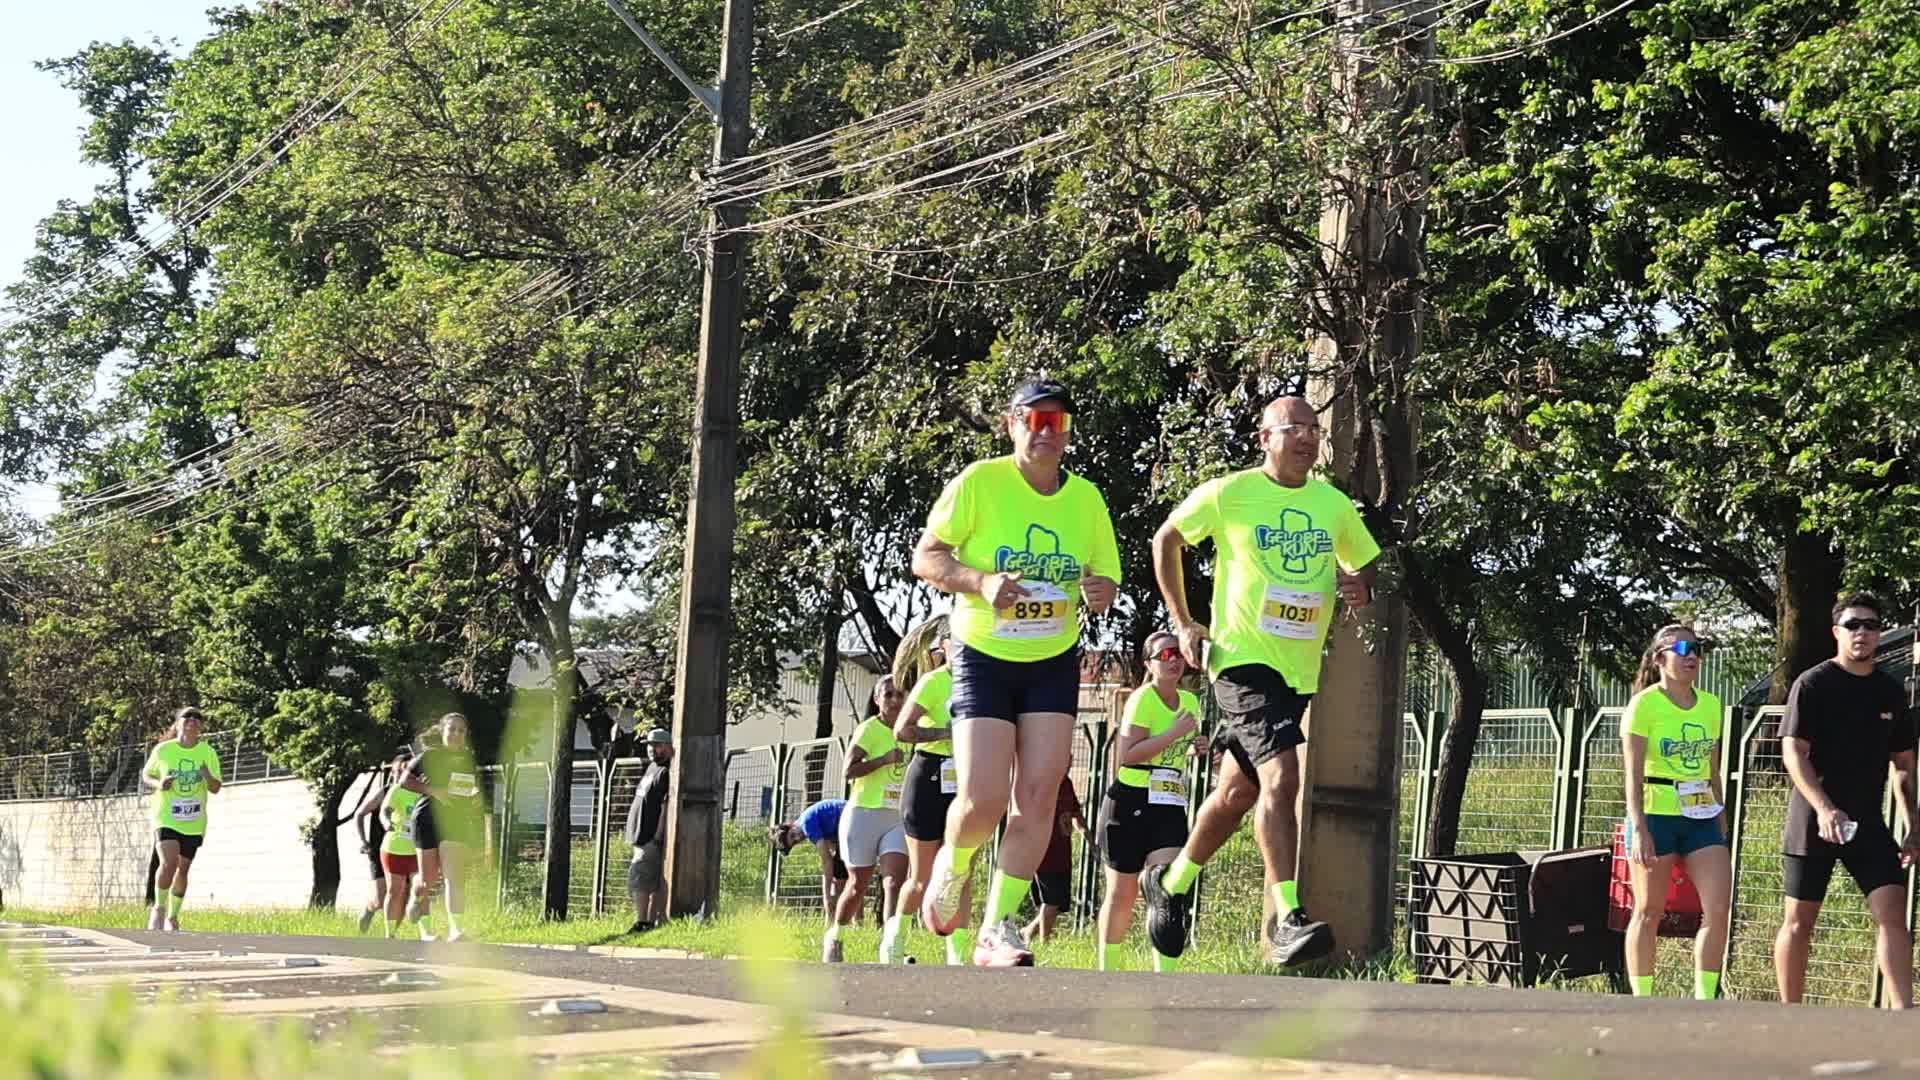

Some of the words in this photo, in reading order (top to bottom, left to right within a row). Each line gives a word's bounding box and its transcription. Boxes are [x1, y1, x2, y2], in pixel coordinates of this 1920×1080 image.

[1282, 540, 1318, 560] RUN
[1015, 601, 1054, 619] 893
[1279, 604, 1313, 622] 1031
